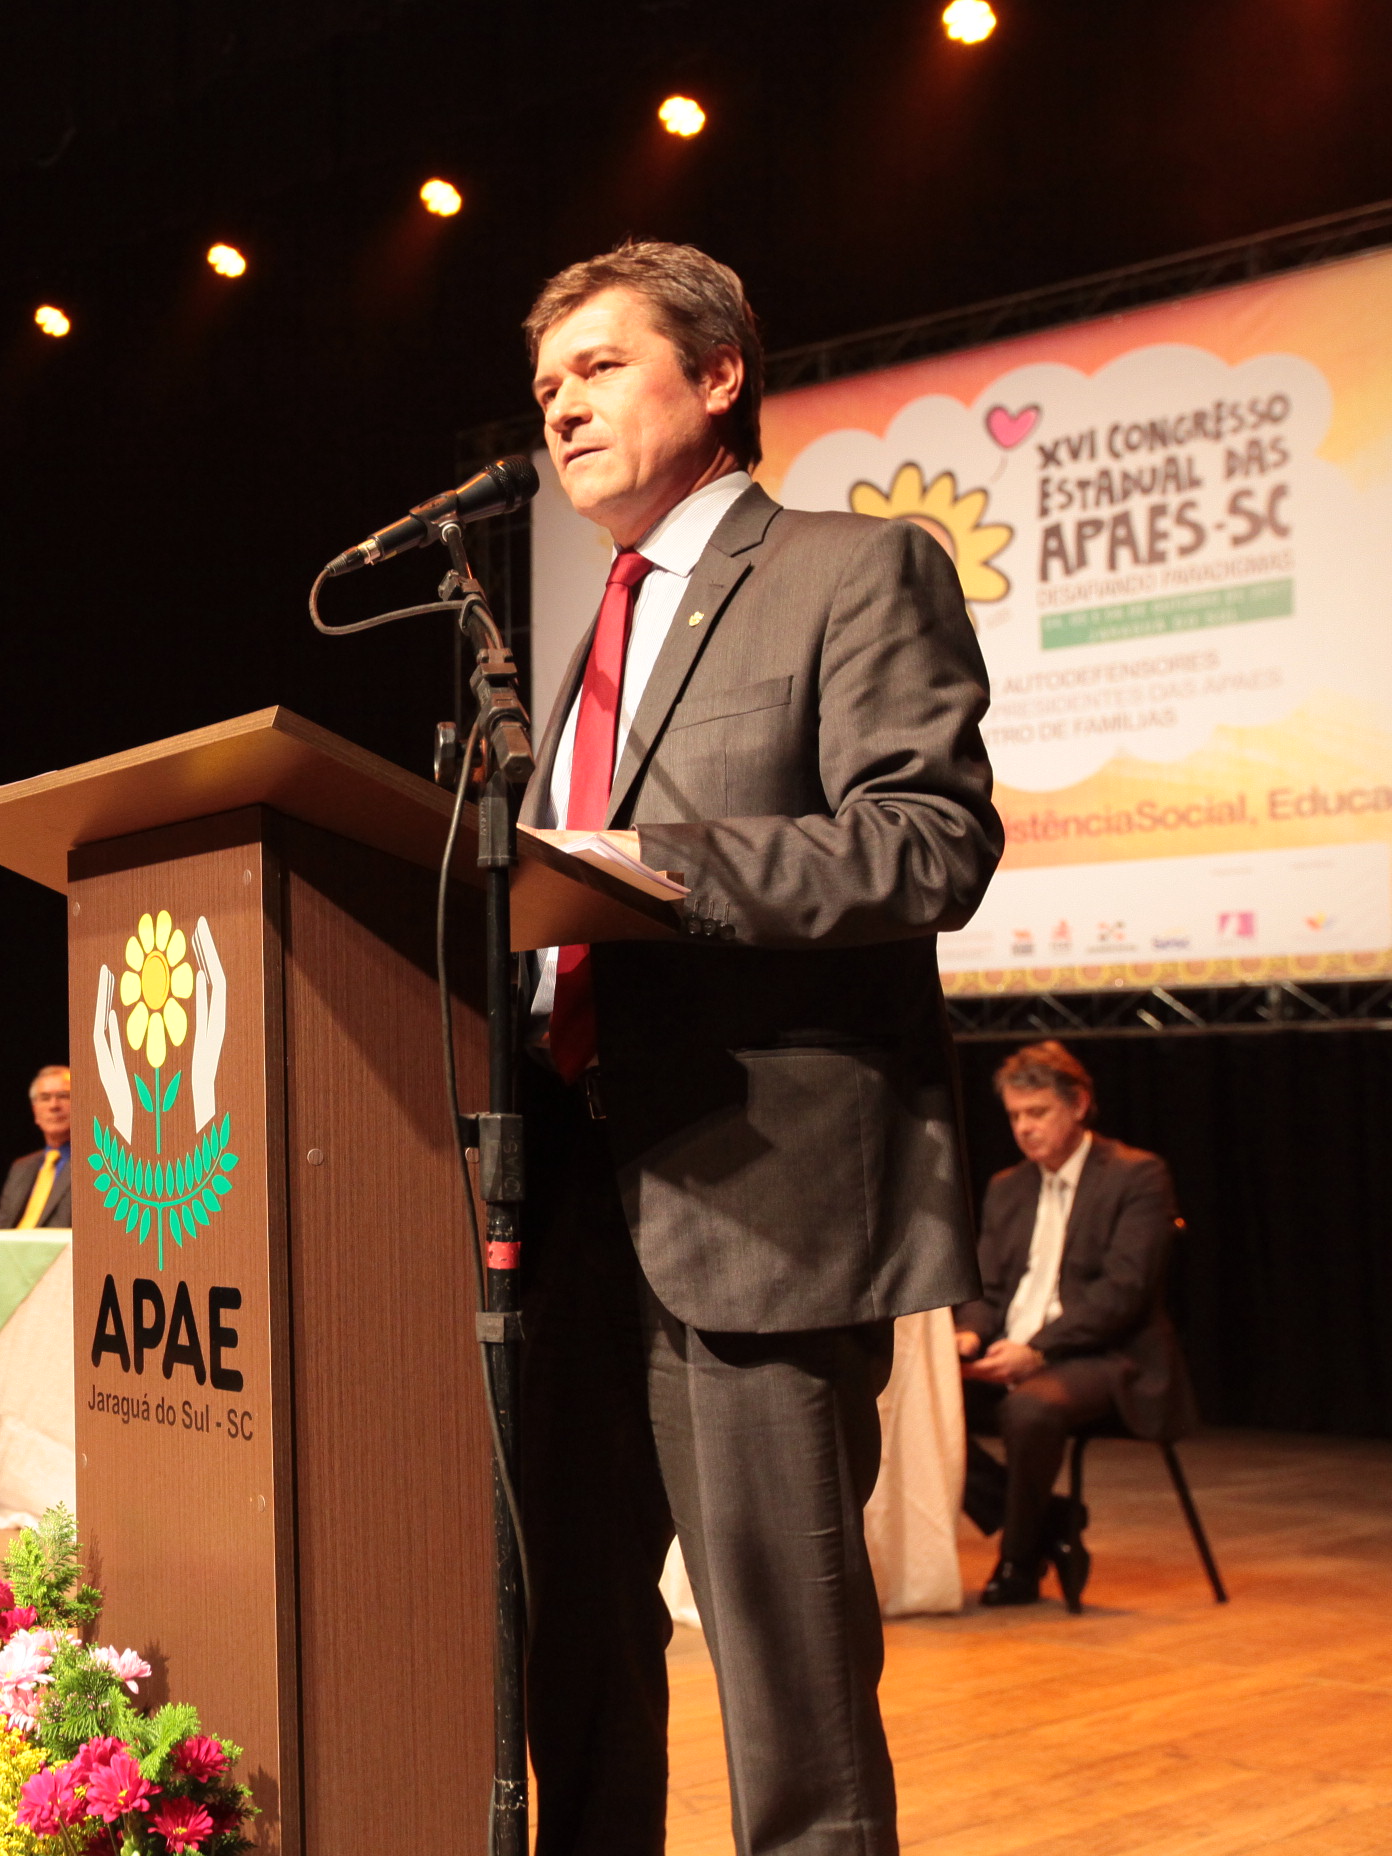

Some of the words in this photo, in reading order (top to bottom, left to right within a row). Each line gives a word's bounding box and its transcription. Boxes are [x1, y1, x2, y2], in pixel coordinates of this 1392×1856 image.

[1036, 429, 1098, 473] XVI
[1108, 392, 1292, 460] CONGRESSO
[1037, 453, 1203, 519] ESTADUAL
[1223, 434, 1292, 480] DAS
[91, 1273, 244, 1393] APAE
[88, 1384, 150, 1425] Jaraguá
[155, 1396, 177, 1427] do
[181, 1400, 210, 1434] Sul
[227, 1408, 254, 1441] SC
